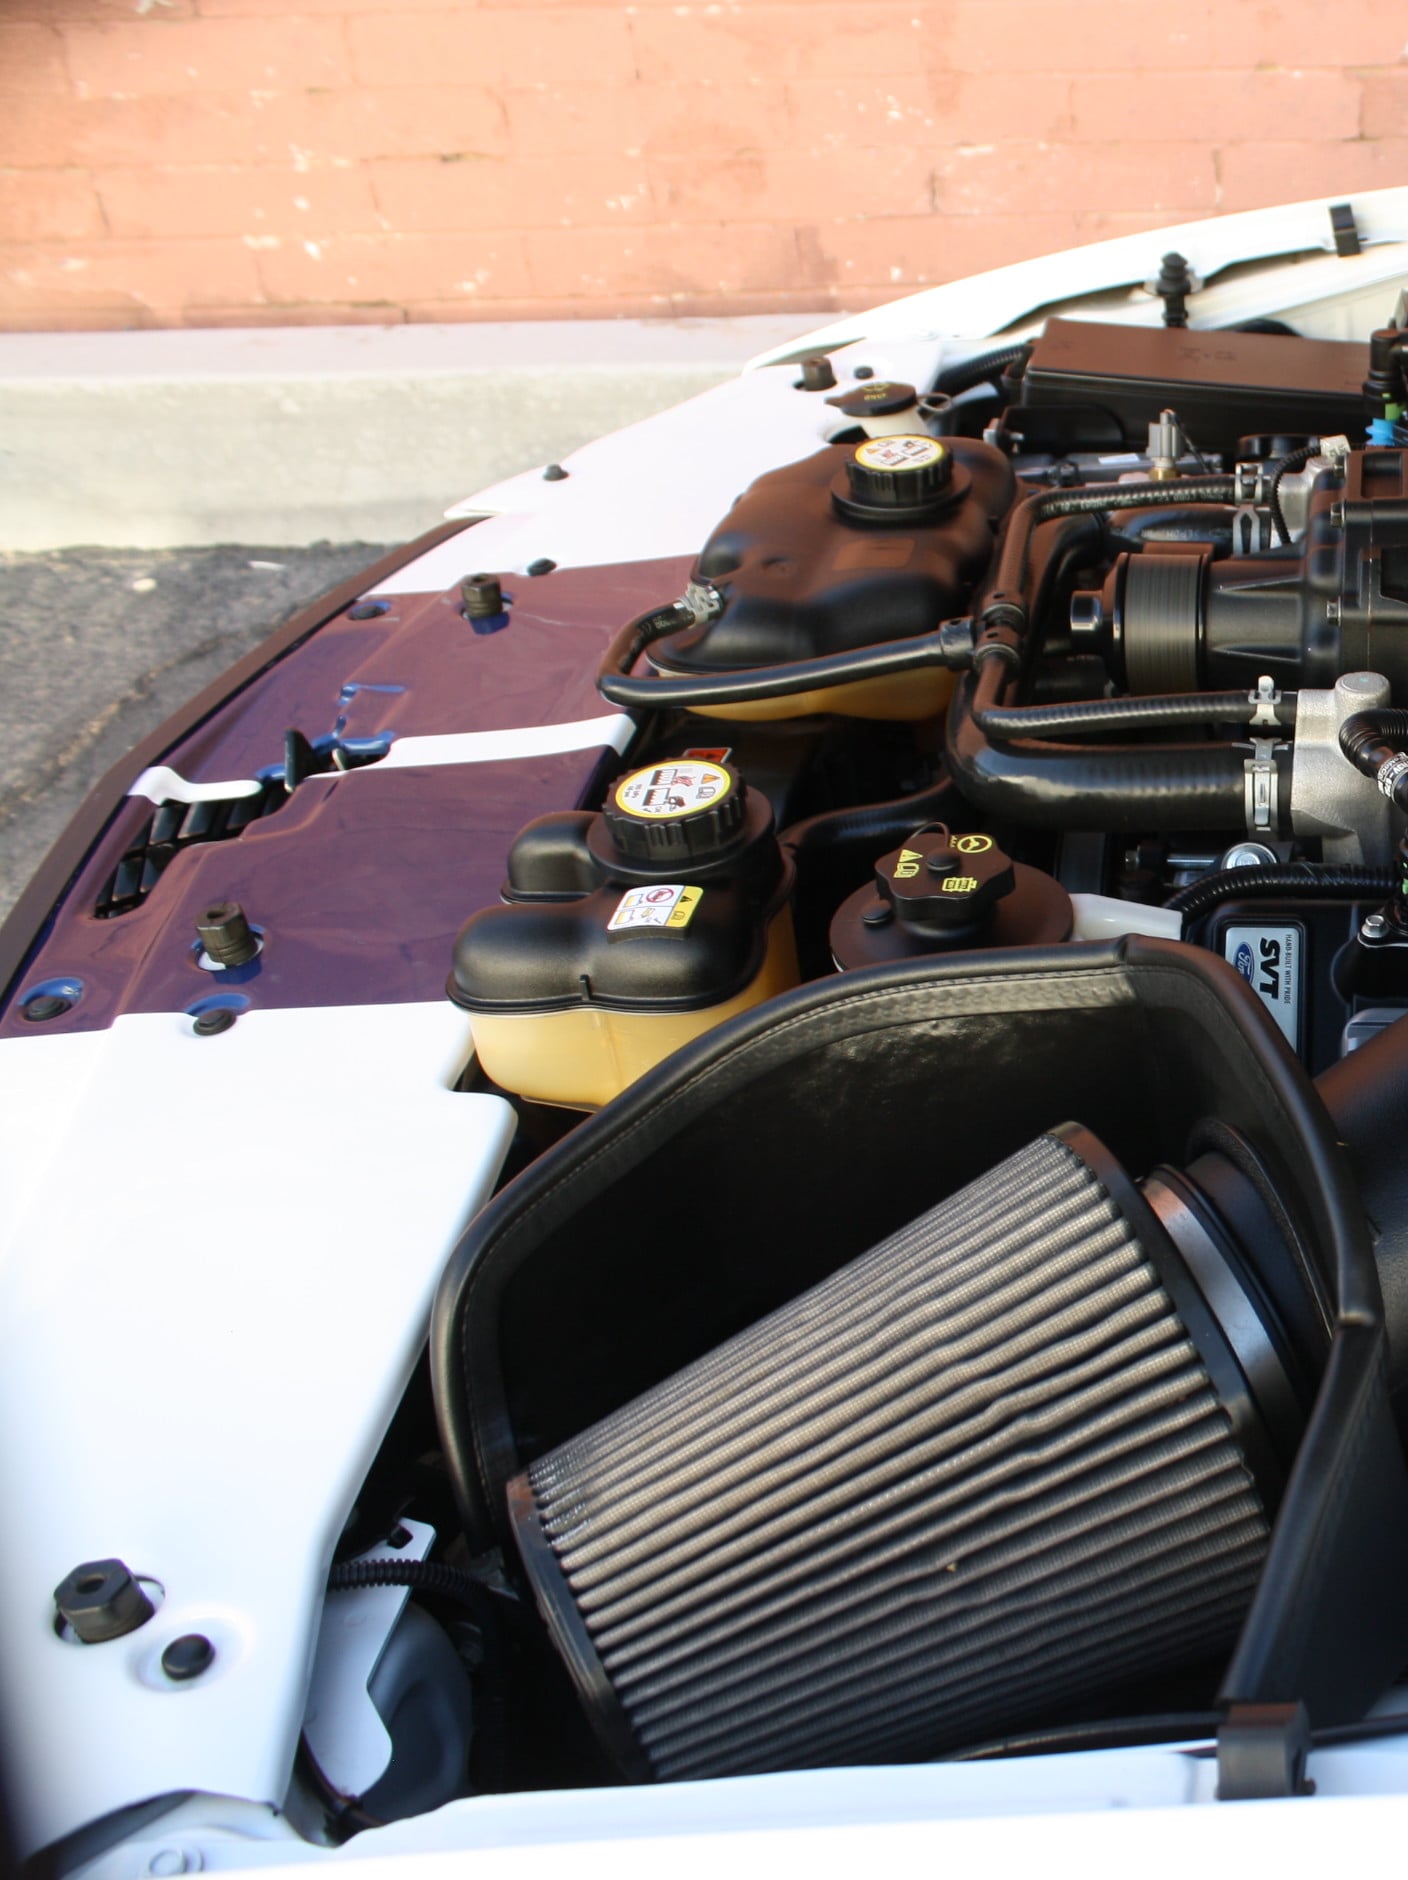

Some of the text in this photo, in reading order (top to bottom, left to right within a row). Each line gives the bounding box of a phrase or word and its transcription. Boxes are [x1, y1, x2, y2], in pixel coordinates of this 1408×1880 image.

[1260, 937, 1280, 1000] SVT
[1284, 970, 1292, 985] WITH
[1283, 986, 1292, 1004] PRIDE
